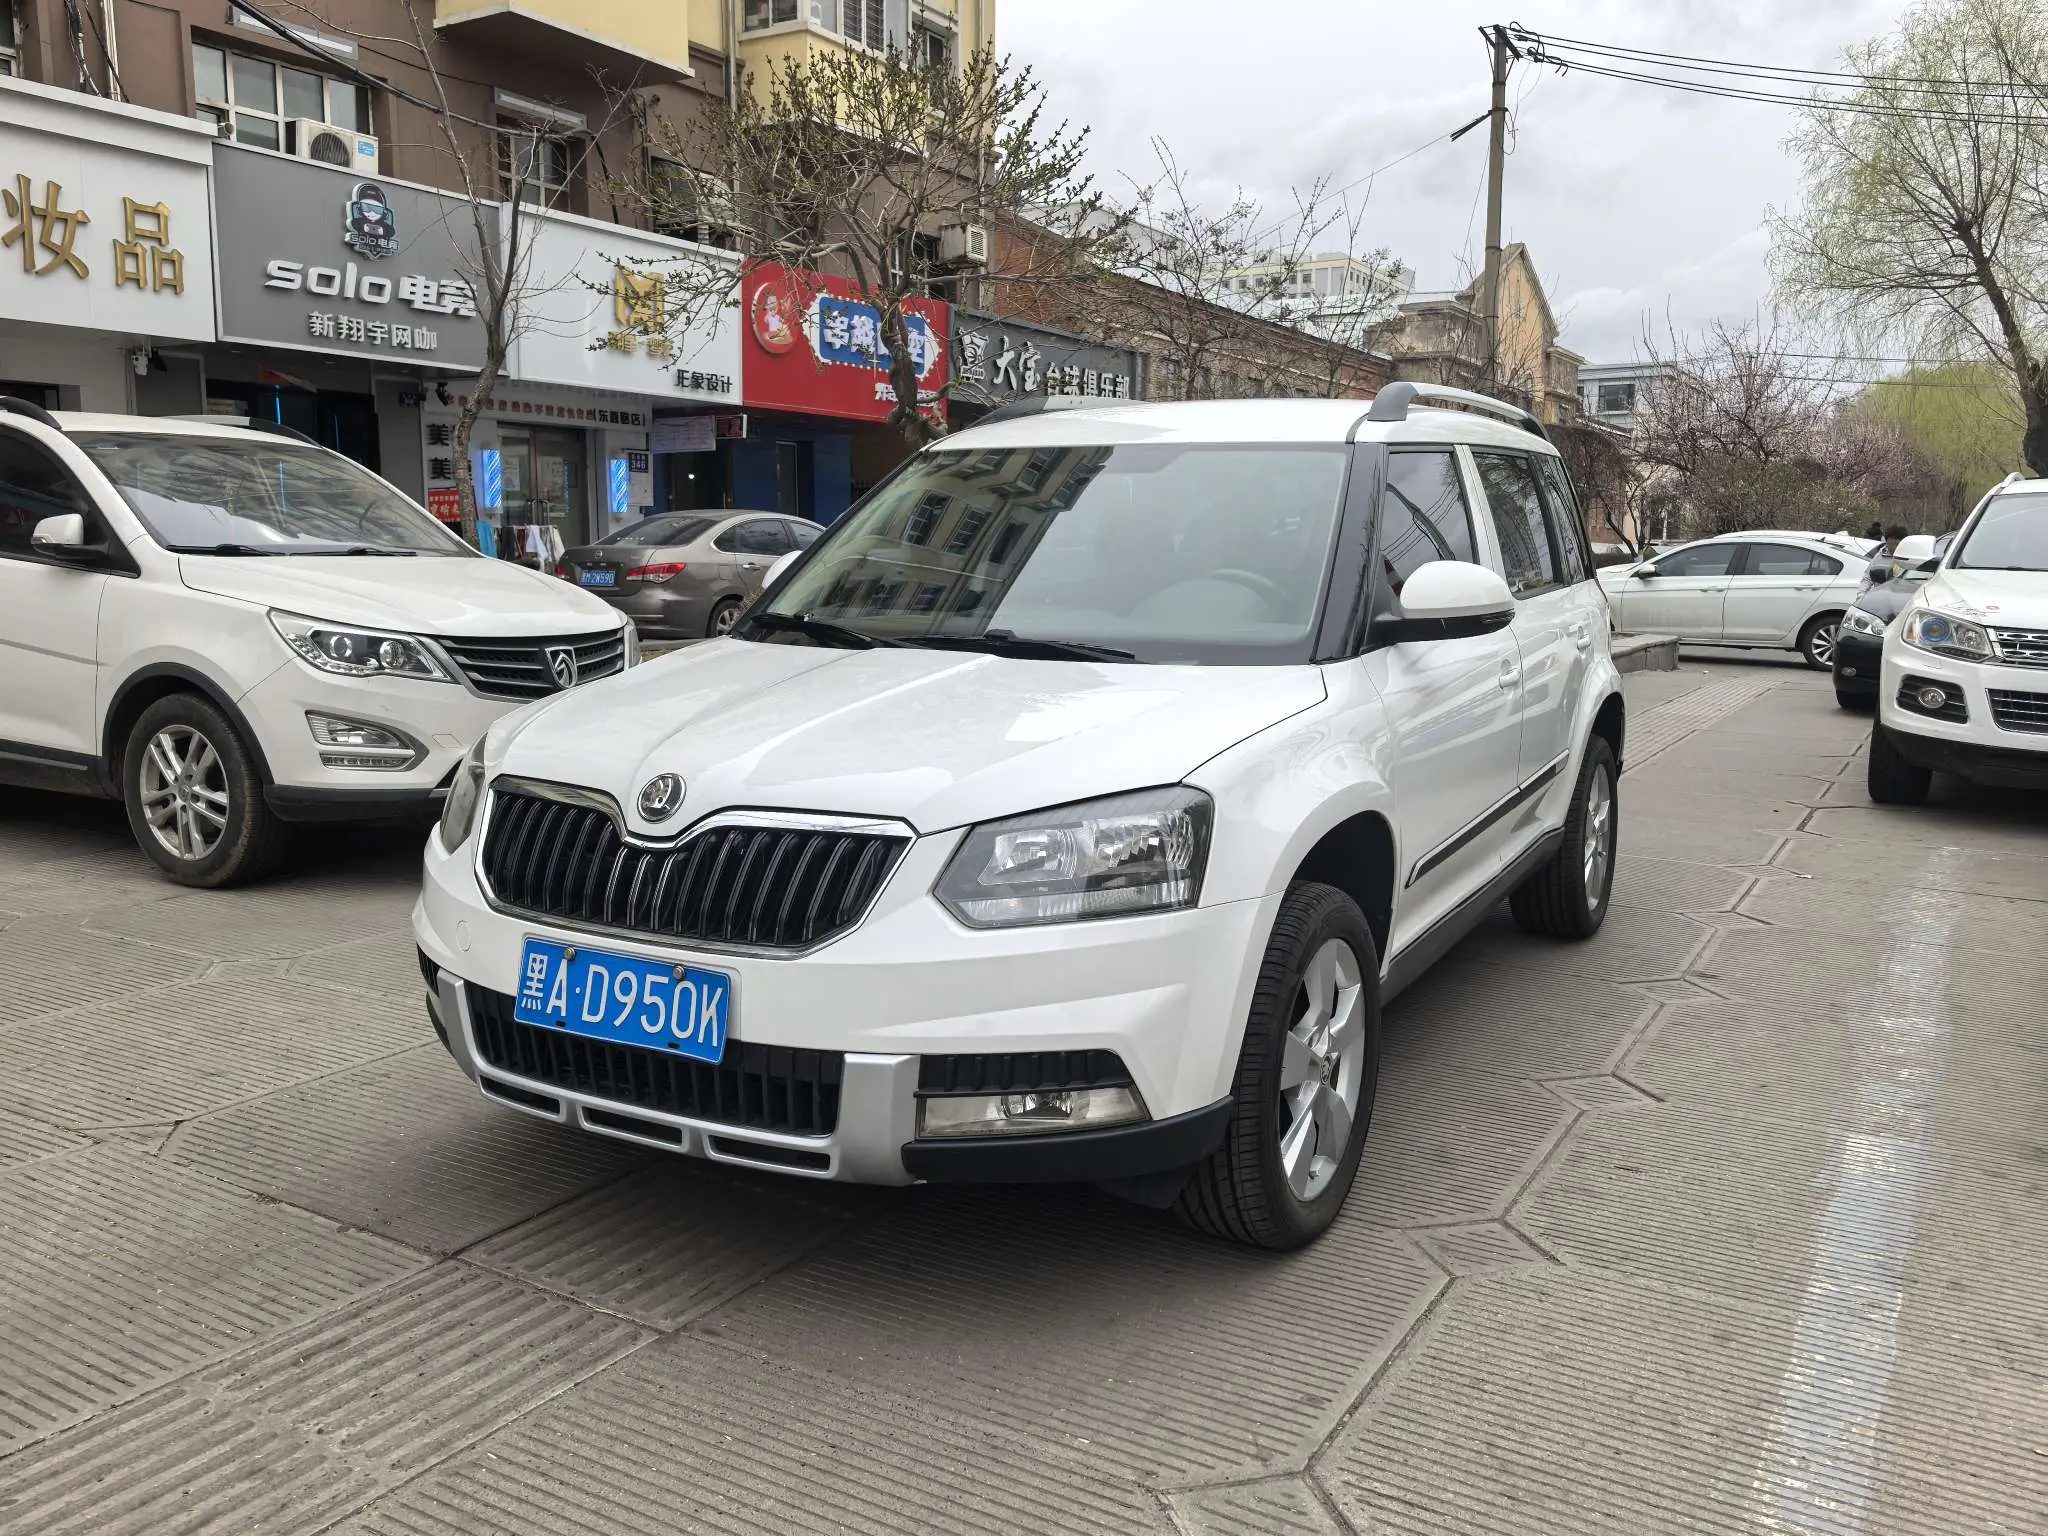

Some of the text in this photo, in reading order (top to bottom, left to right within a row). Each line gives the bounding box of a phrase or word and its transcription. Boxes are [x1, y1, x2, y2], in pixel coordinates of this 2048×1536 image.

[1, 173, 186, 295] 妆品
[263, 259, 477, 318] solo 电竞
[307, 310, 439, 351] 新翔宇网咖
[1046, 361, 1130, 400] 台球俱乐部
[520, 952, 723, 1047] 黑A·D950K
